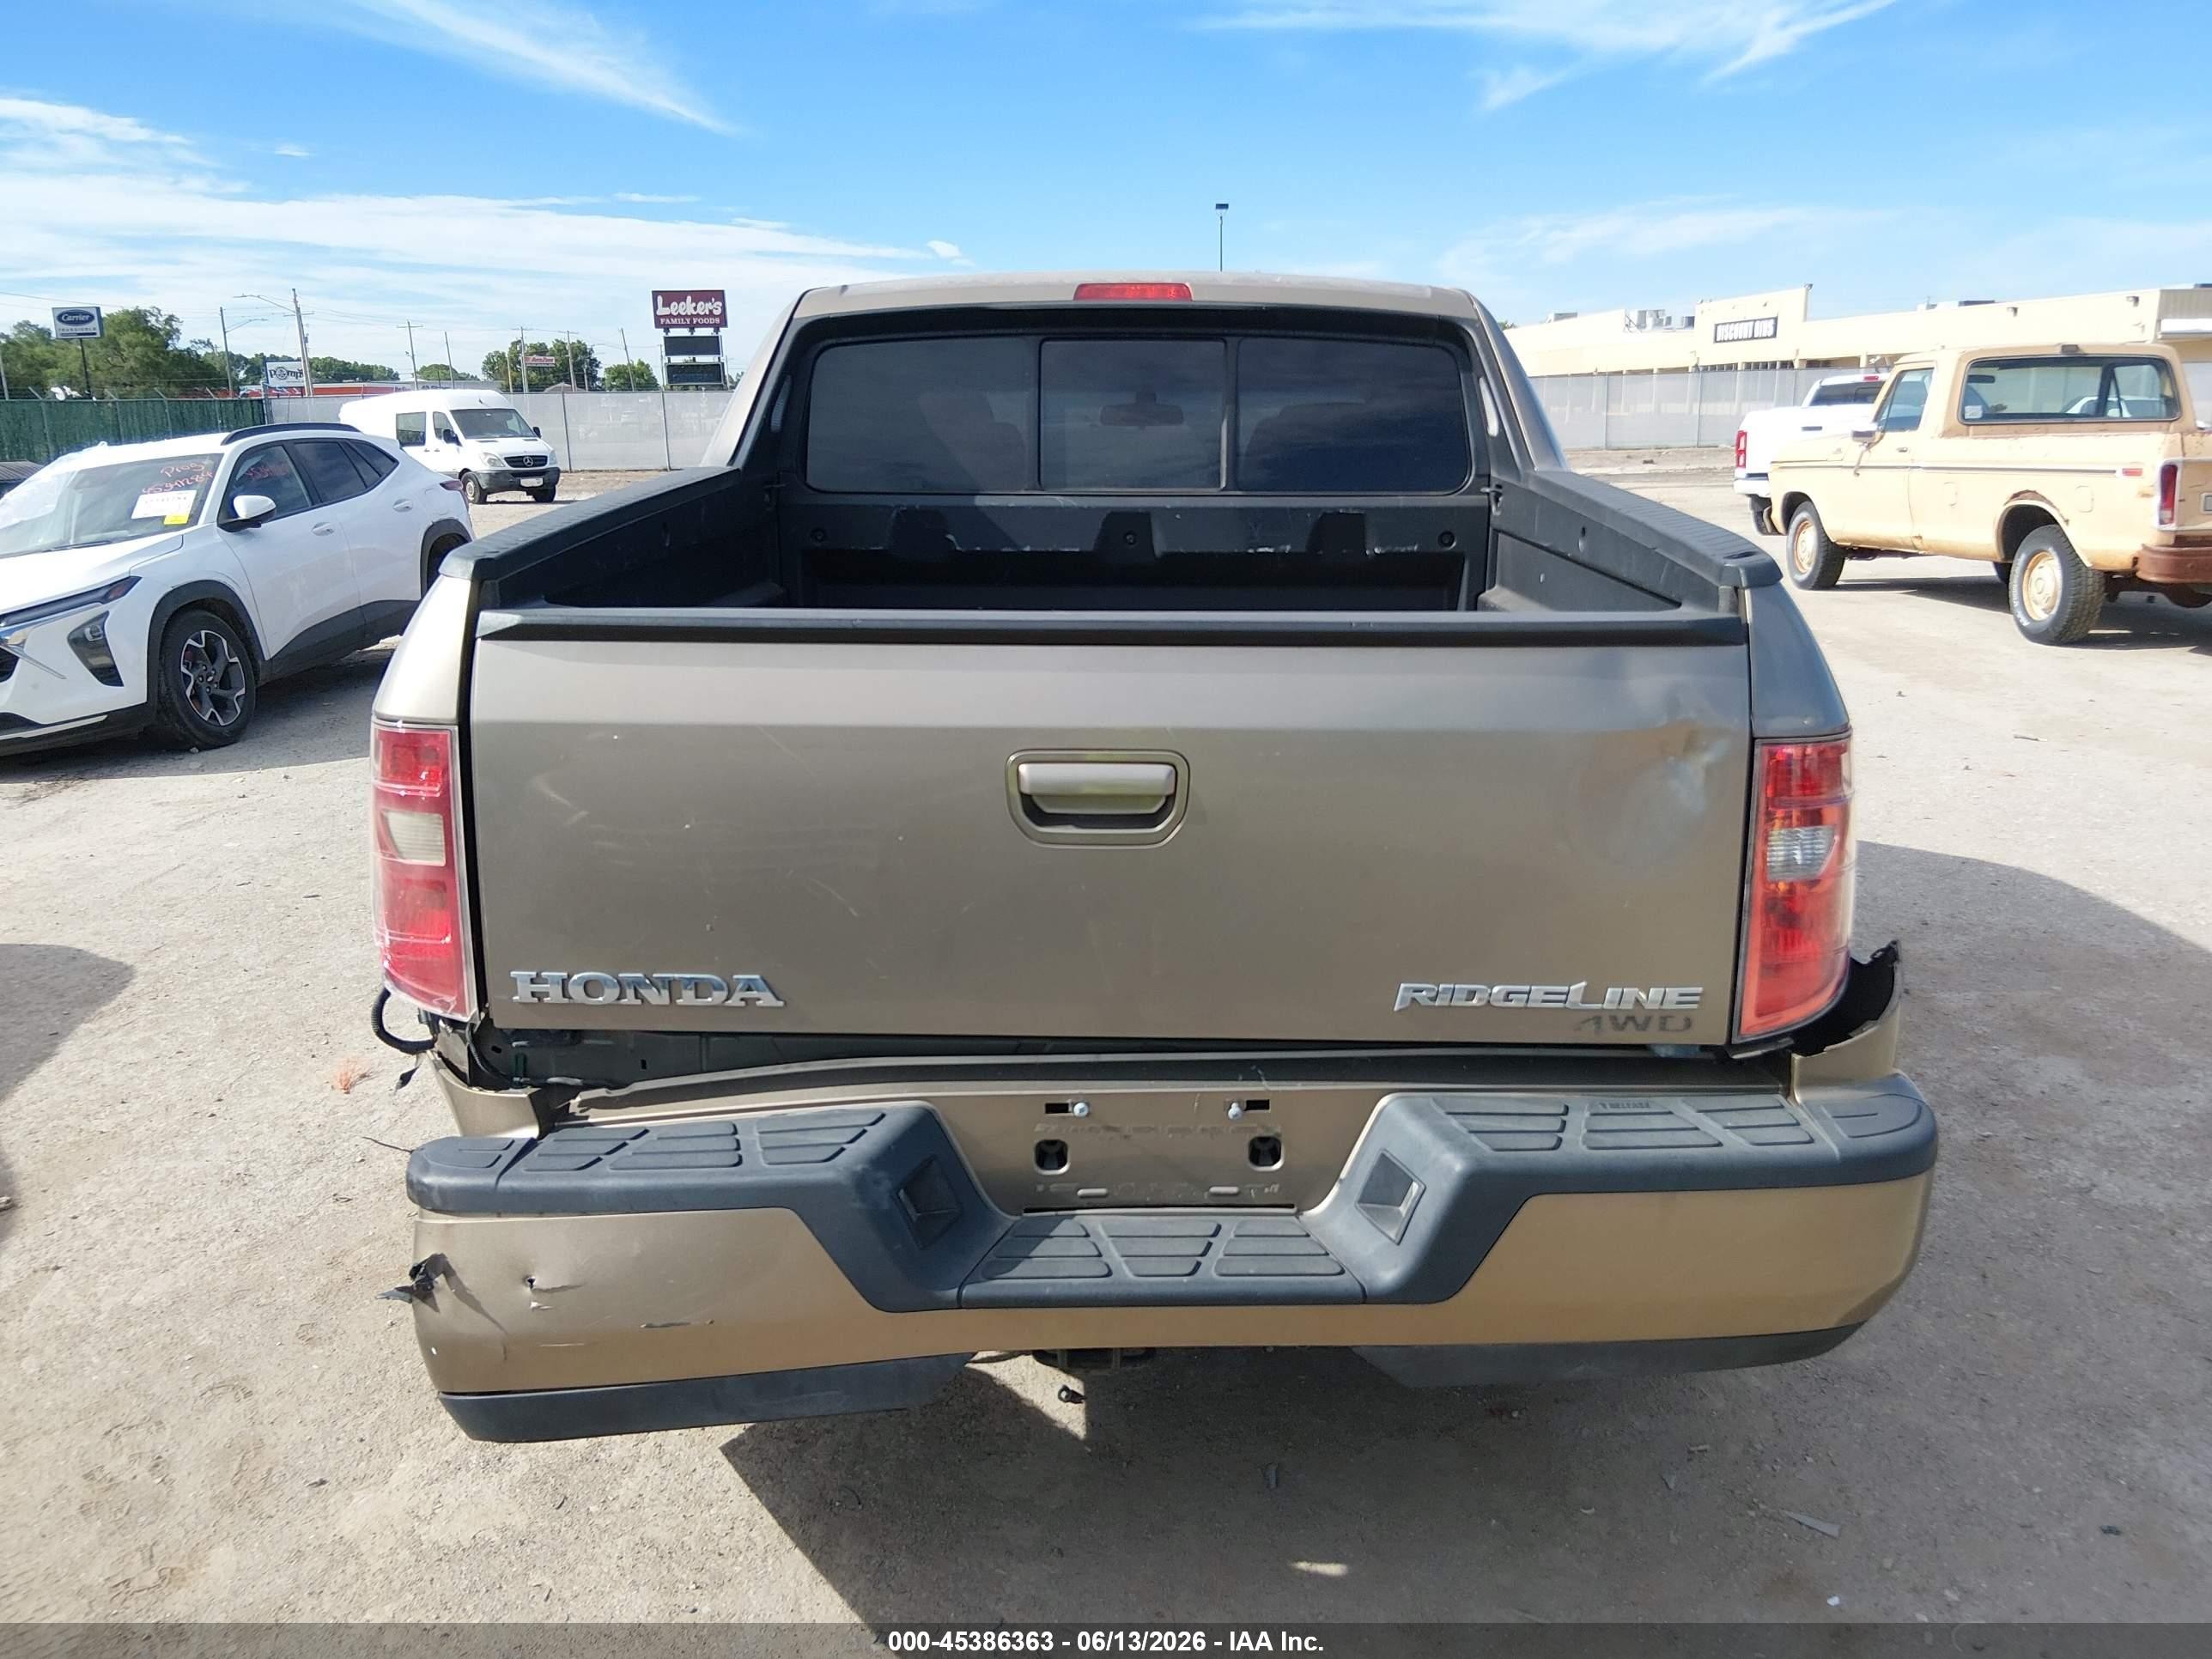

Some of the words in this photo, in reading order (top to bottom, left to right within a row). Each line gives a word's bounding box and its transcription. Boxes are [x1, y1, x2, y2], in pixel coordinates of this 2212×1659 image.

[61, 313, 91, 322] Carrier
[656, 295, 723, 316] Leeker's
[509, 969, 786, 1008] HONDA
[1394, 981, 1704, 1012] RIDGELINE
